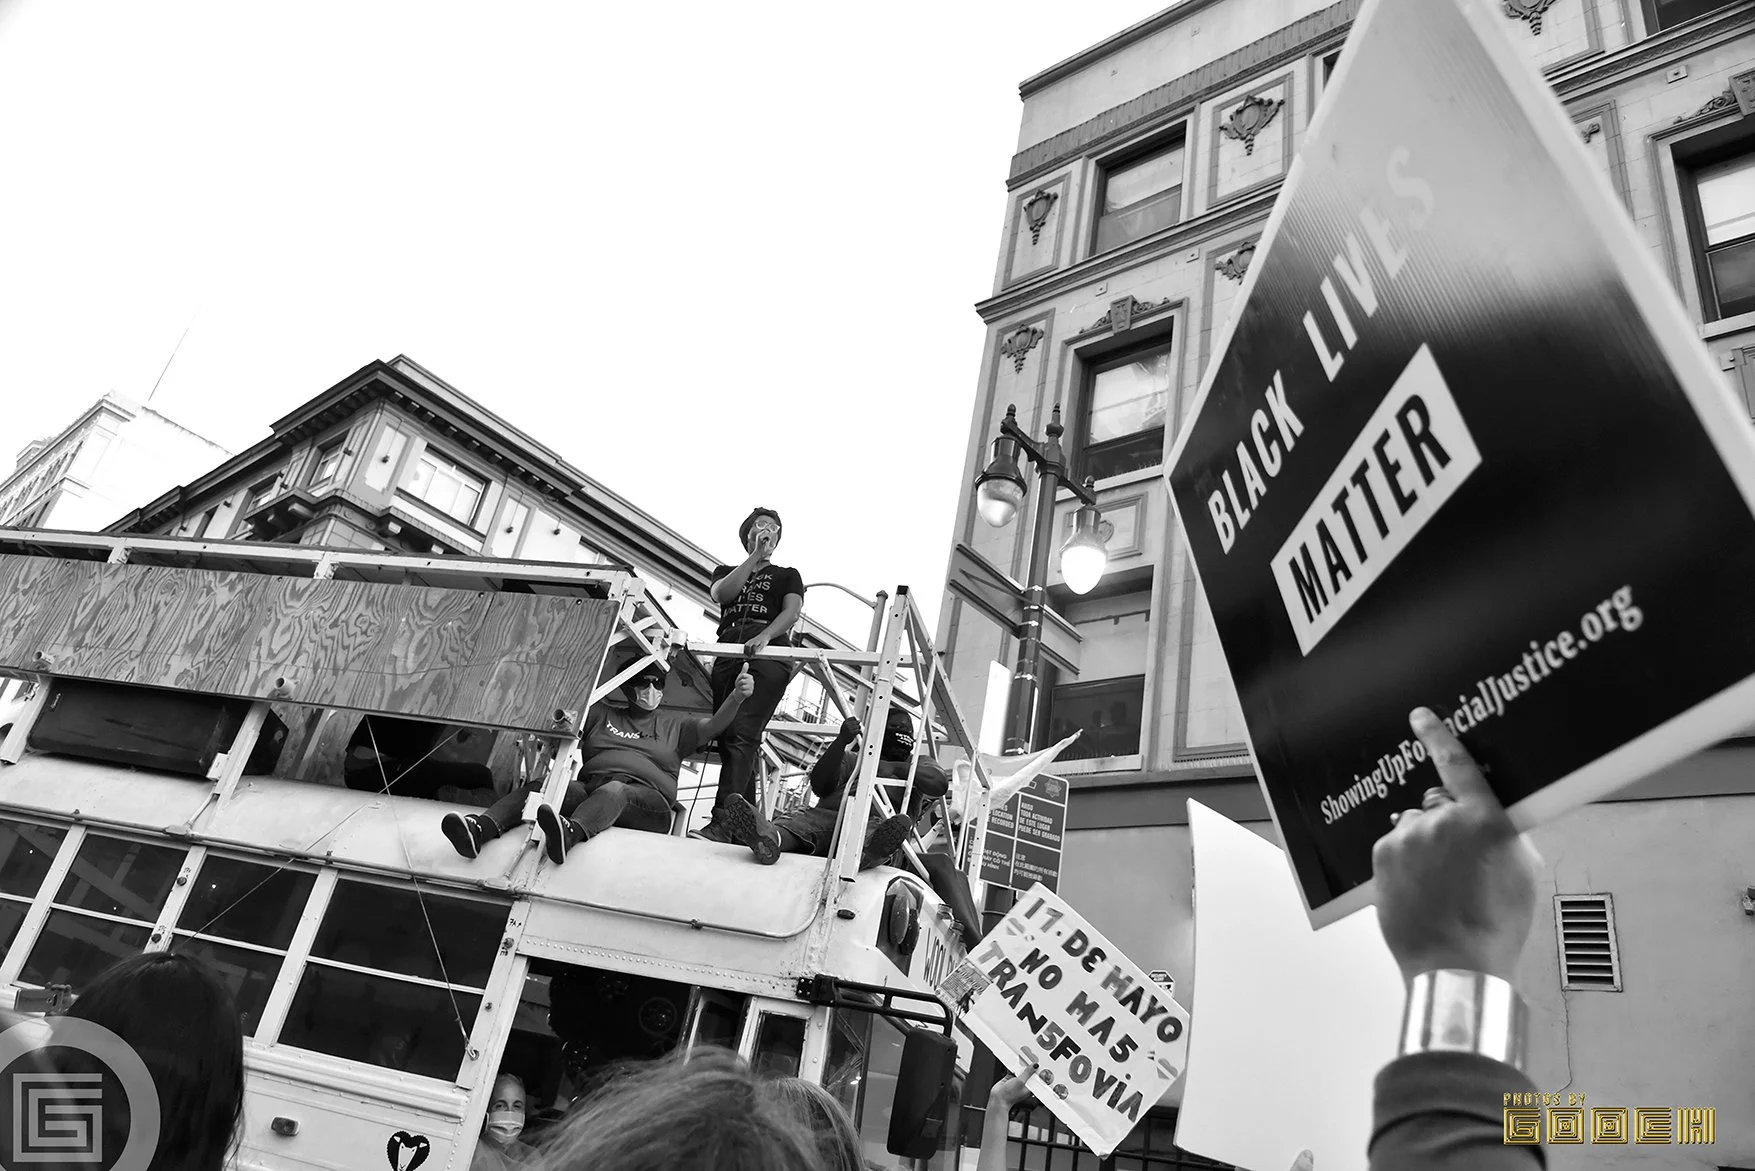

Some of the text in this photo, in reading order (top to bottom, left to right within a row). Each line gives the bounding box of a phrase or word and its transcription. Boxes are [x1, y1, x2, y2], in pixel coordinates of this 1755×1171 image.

[1207, 145, 1435, 555] BLACK LIVES
[1288, 393, 1452, 625] MATTER
[606, 720, 641, 740] TRANS
[1018, 947, 1063, 990] NO
[1061, 928, 1107, 974] DE
[1100, 964, 1183, 1043] MAYO
